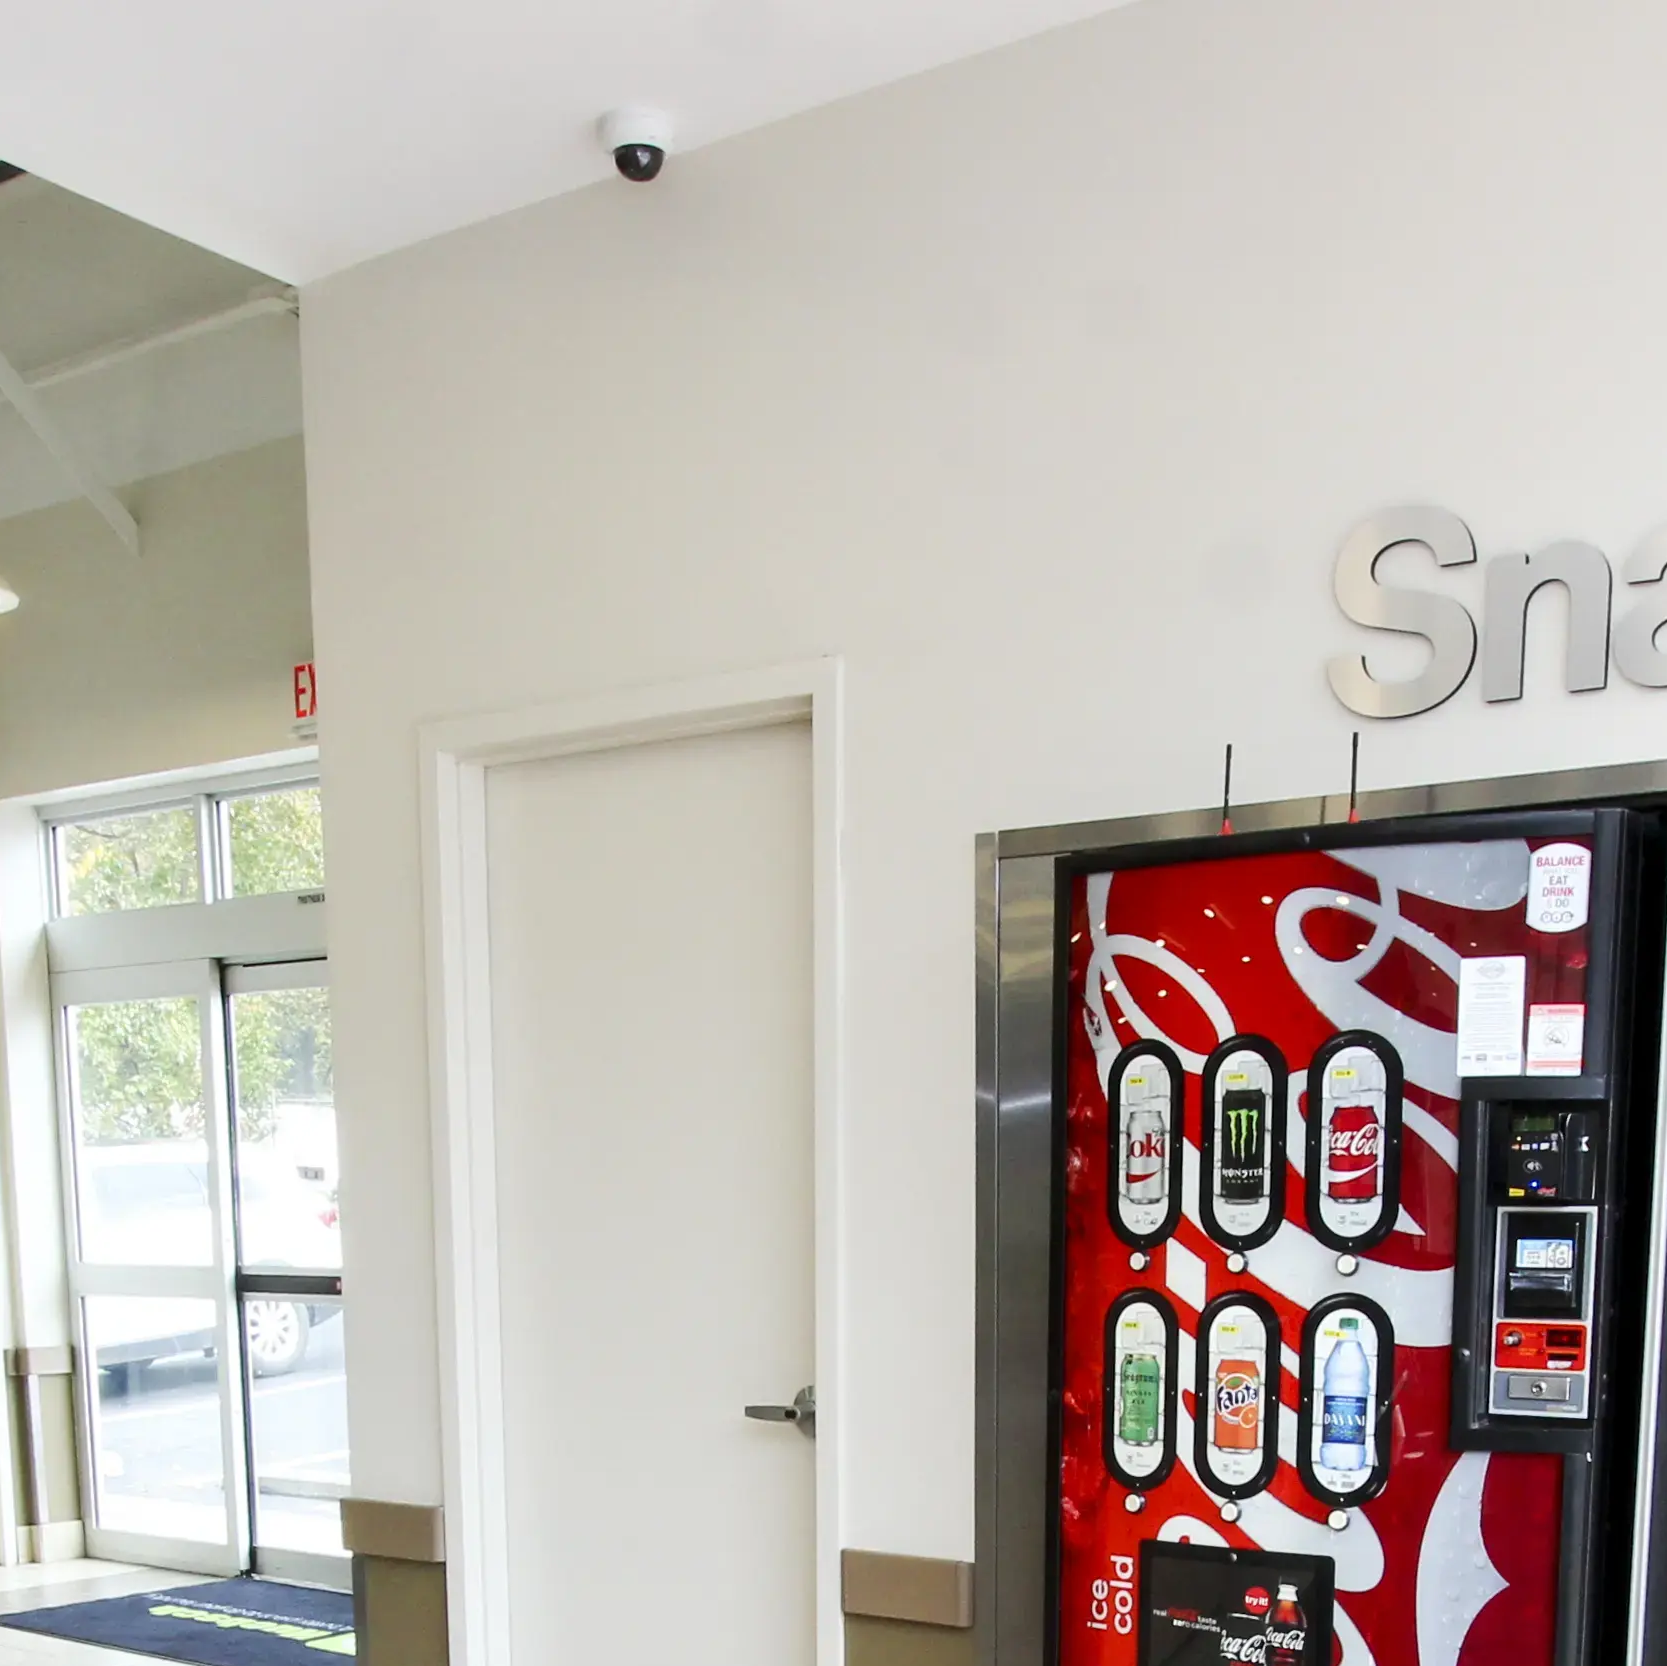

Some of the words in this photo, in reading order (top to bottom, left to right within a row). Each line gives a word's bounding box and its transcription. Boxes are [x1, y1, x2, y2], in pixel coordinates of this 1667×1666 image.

[294, 663, 317, 718] EX
[1536, 855, 1585, 867] BALANCE
[1549, 875, 1568, 886] EAT
[1542, 886, 1575, 897] DRINK
[1222, 1167, 1264, 1179] MONSTER
[1110, 1555, 1134, 1635] cold
[1245, 1595, 1258, 1607] try
[1258, 1595, 1269, 1607] it!
[1087, 1579, 1108, 1630] ice
[1153, 1608, 1168, 1617] real
[1197, 1615, 1217, 1625] taste
[1191, 1620, 1221, 1633] calories
